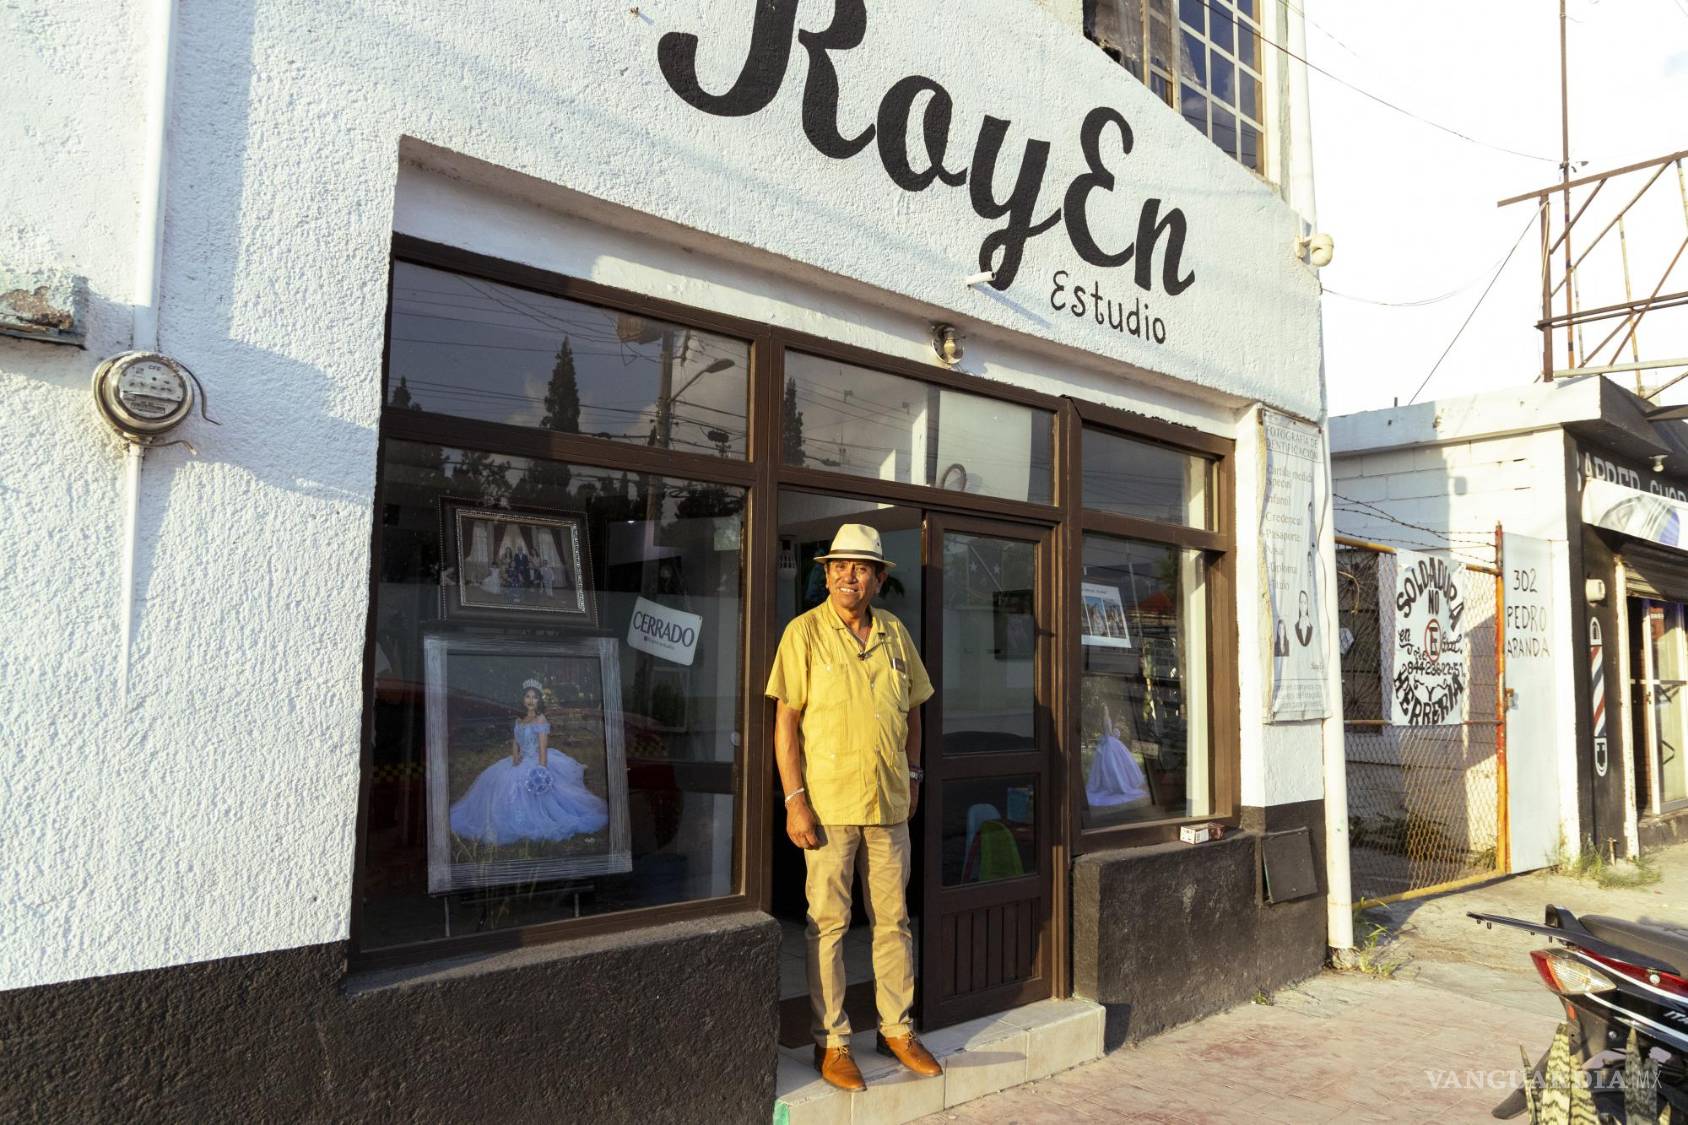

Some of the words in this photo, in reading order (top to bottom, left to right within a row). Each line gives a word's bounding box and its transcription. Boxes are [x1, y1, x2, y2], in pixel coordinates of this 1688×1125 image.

[1050, 269, 1167, 345] Estudio
[1396, 557, 1465, 632] SOLDADURA
[1513, 568, 1538, 593] 302
[1428, 589, 1439, 616] NO
[633, 611, 695, 648] CERRADO
[1506, 604, 1547, 632] PEDRO
[1503, 637, 1551, 658] ARANDA
